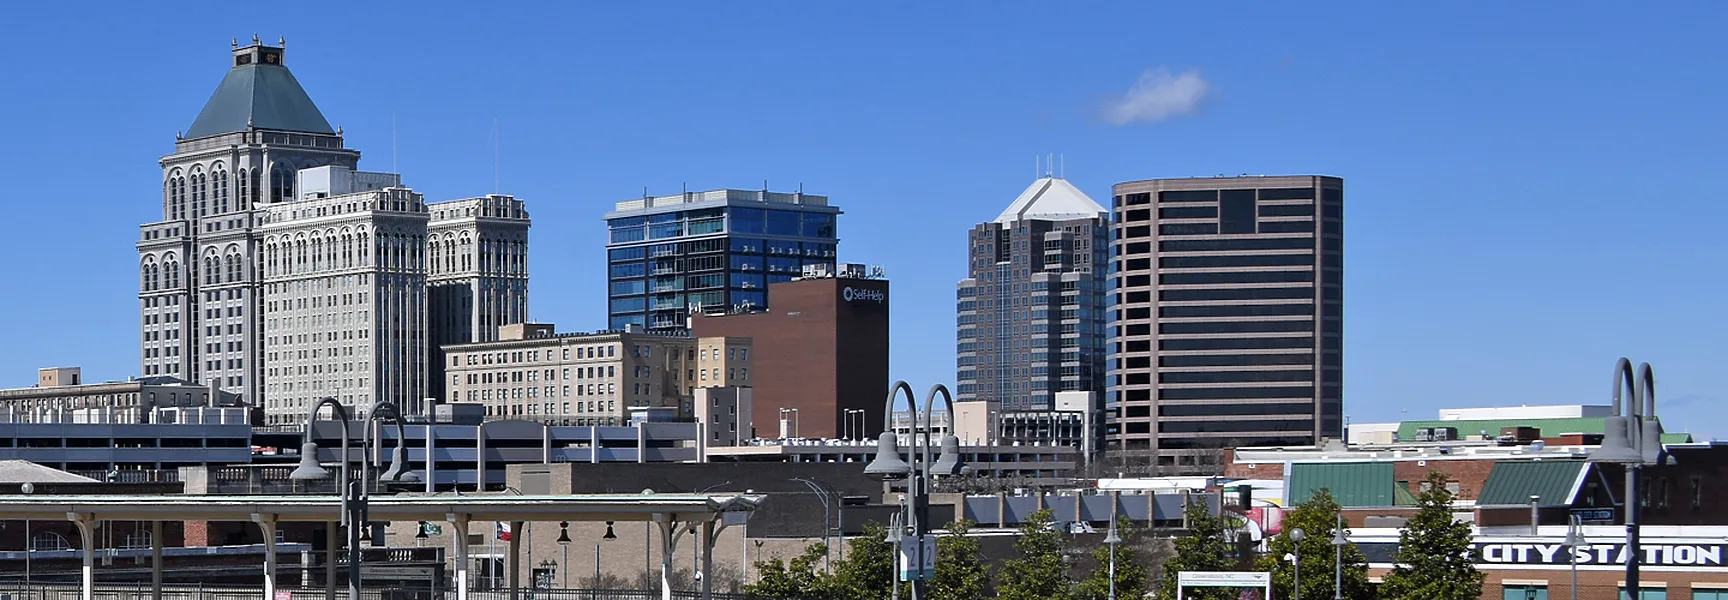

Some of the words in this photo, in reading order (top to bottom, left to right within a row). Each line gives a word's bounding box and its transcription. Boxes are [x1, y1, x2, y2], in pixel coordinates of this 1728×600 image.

[853, 289, 884, 304] Self-Help
[910, 546, 916, 566] 2
[925, 545, 932, 565] 2
[1483, 544, 1562, 562] CITY
